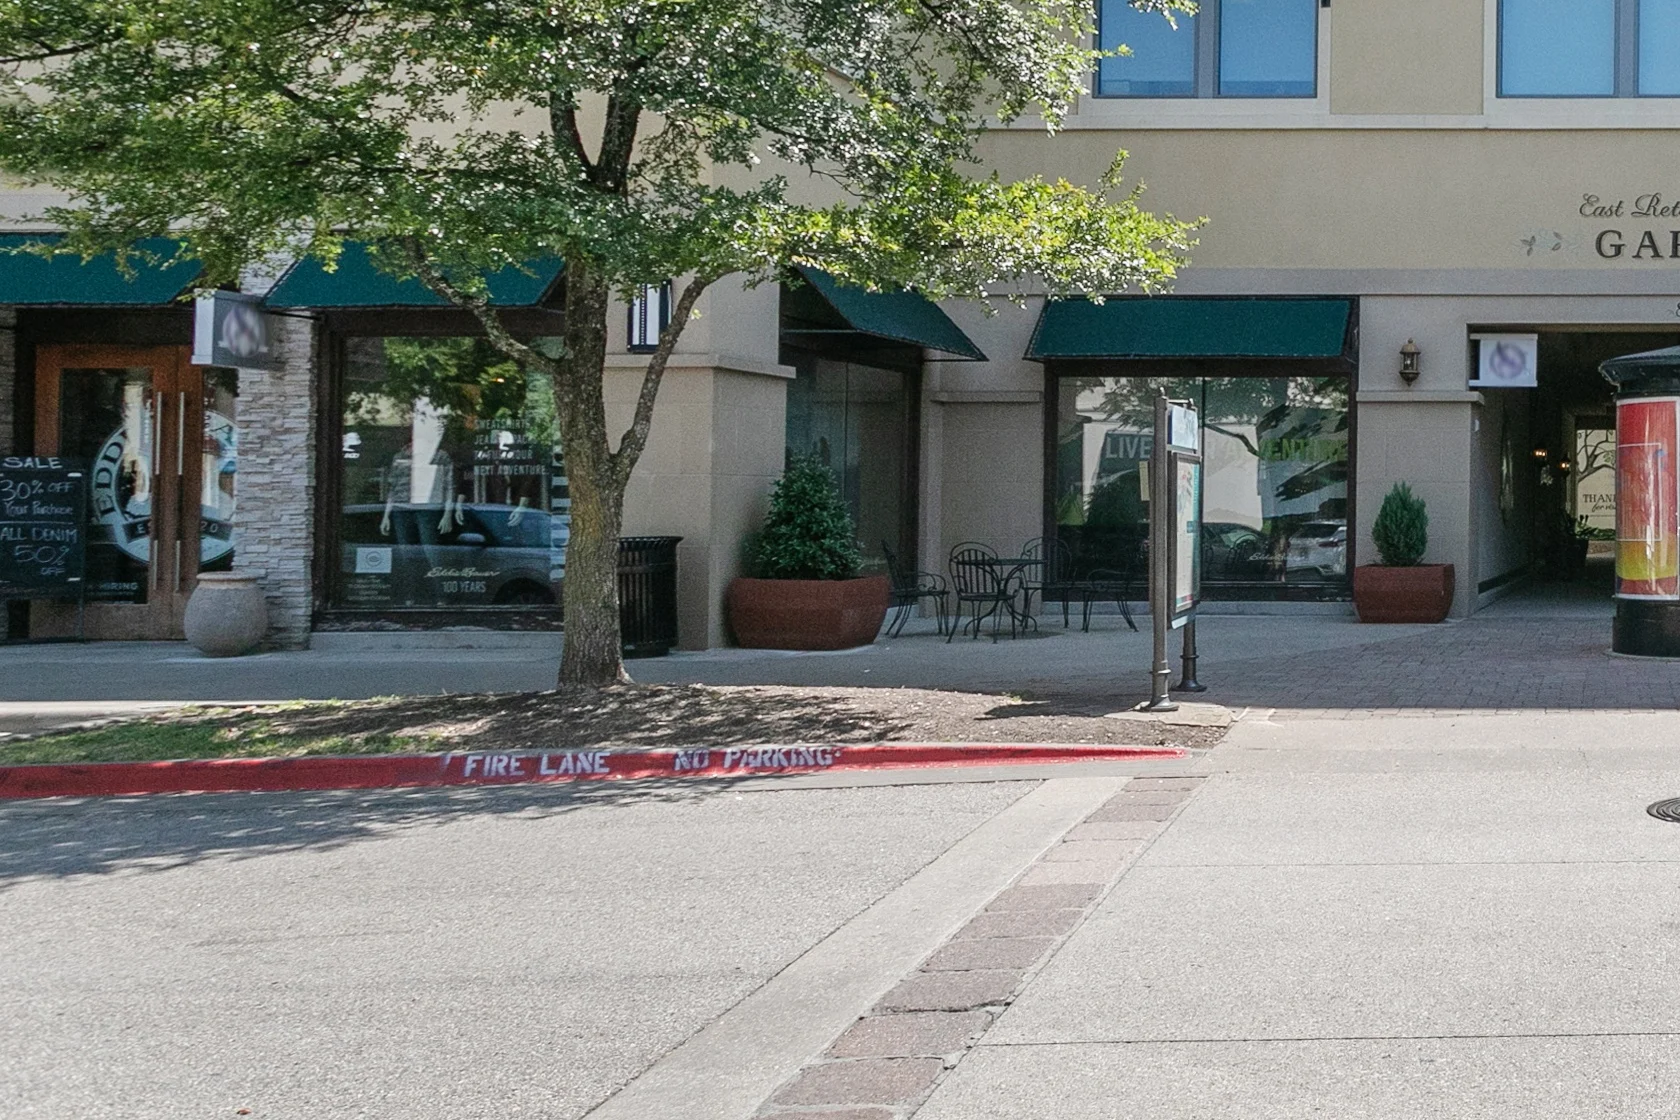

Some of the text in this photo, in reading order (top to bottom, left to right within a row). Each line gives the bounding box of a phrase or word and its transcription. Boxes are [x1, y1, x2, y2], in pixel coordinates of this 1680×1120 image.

[1579, 193, 1625, 218] East
[1106, 436, 1150, 460] LIVE
[2, 457, 63, 469] SALE
[47, 482, 74, 493] OFF
[0, 527, 77, 543] ALL DENIM
[14, 544, 70, 566] 50%
[40, 567, 65, 576] OFF
[460, 581, 487, 593] YEARS
[463, 747, 835, 777] FIRE LANE NO PARKING
